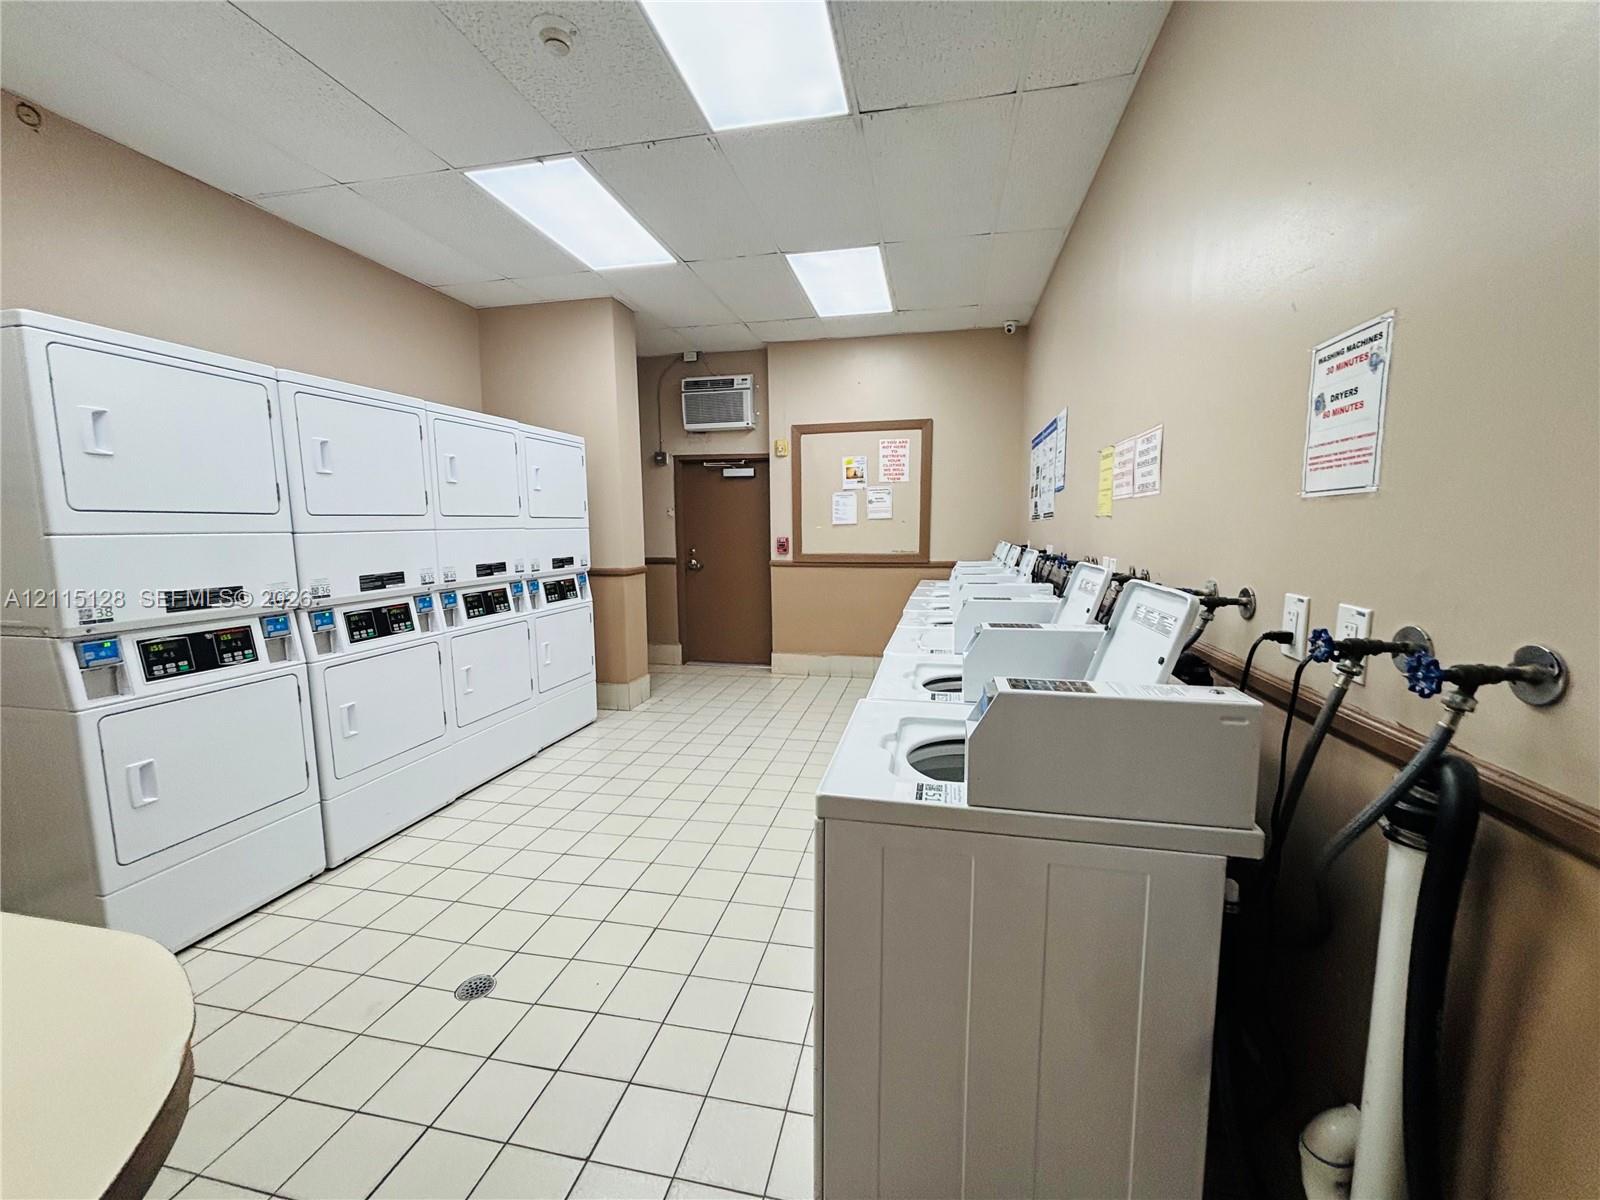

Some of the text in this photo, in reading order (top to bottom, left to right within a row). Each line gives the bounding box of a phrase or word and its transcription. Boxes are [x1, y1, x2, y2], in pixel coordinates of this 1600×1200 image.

[1318, 331, 1383, 365] WASHING MACHINES
[1326, 351, 1369, 376] 30 MINUTES
[1330, 386, 1358, 403] DRYERS
[1332, 400, 1364, 417] MINUTES
[320, 586, 331, 595] 36
[95, 607, 114, 618] 38
